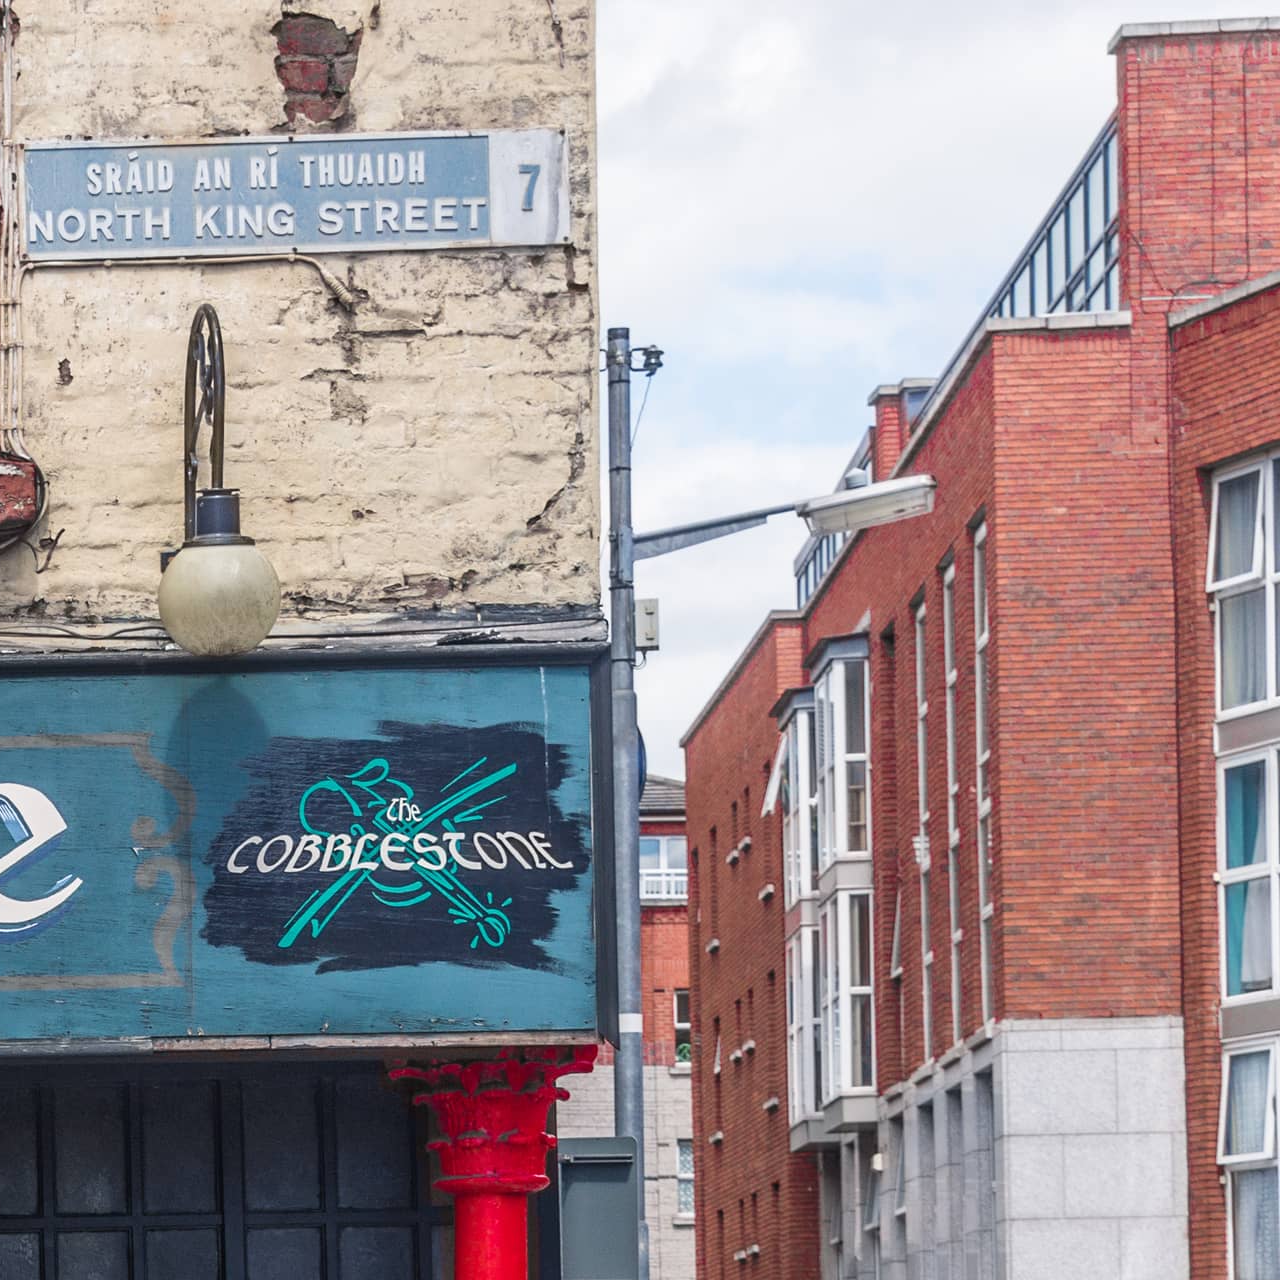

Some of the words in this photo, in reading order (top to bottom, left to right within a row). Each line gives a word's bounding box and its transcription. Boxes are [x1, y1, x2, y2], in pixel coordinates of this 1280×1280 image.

[87, 152, 173, 195] SRÁID
[193, 157, 231, 191] AN
[250, 146, 279, 189] RÍ
[299, 151, 425, 188] THUAIDH
[517, 164, 542, 212] 7
[28, 207, 171, 242] NORTH
[195, 203, 296, 238] KING
[318, 197, 487, 236] STREET
[226, 831, 573, 874] COBBLESTONE
